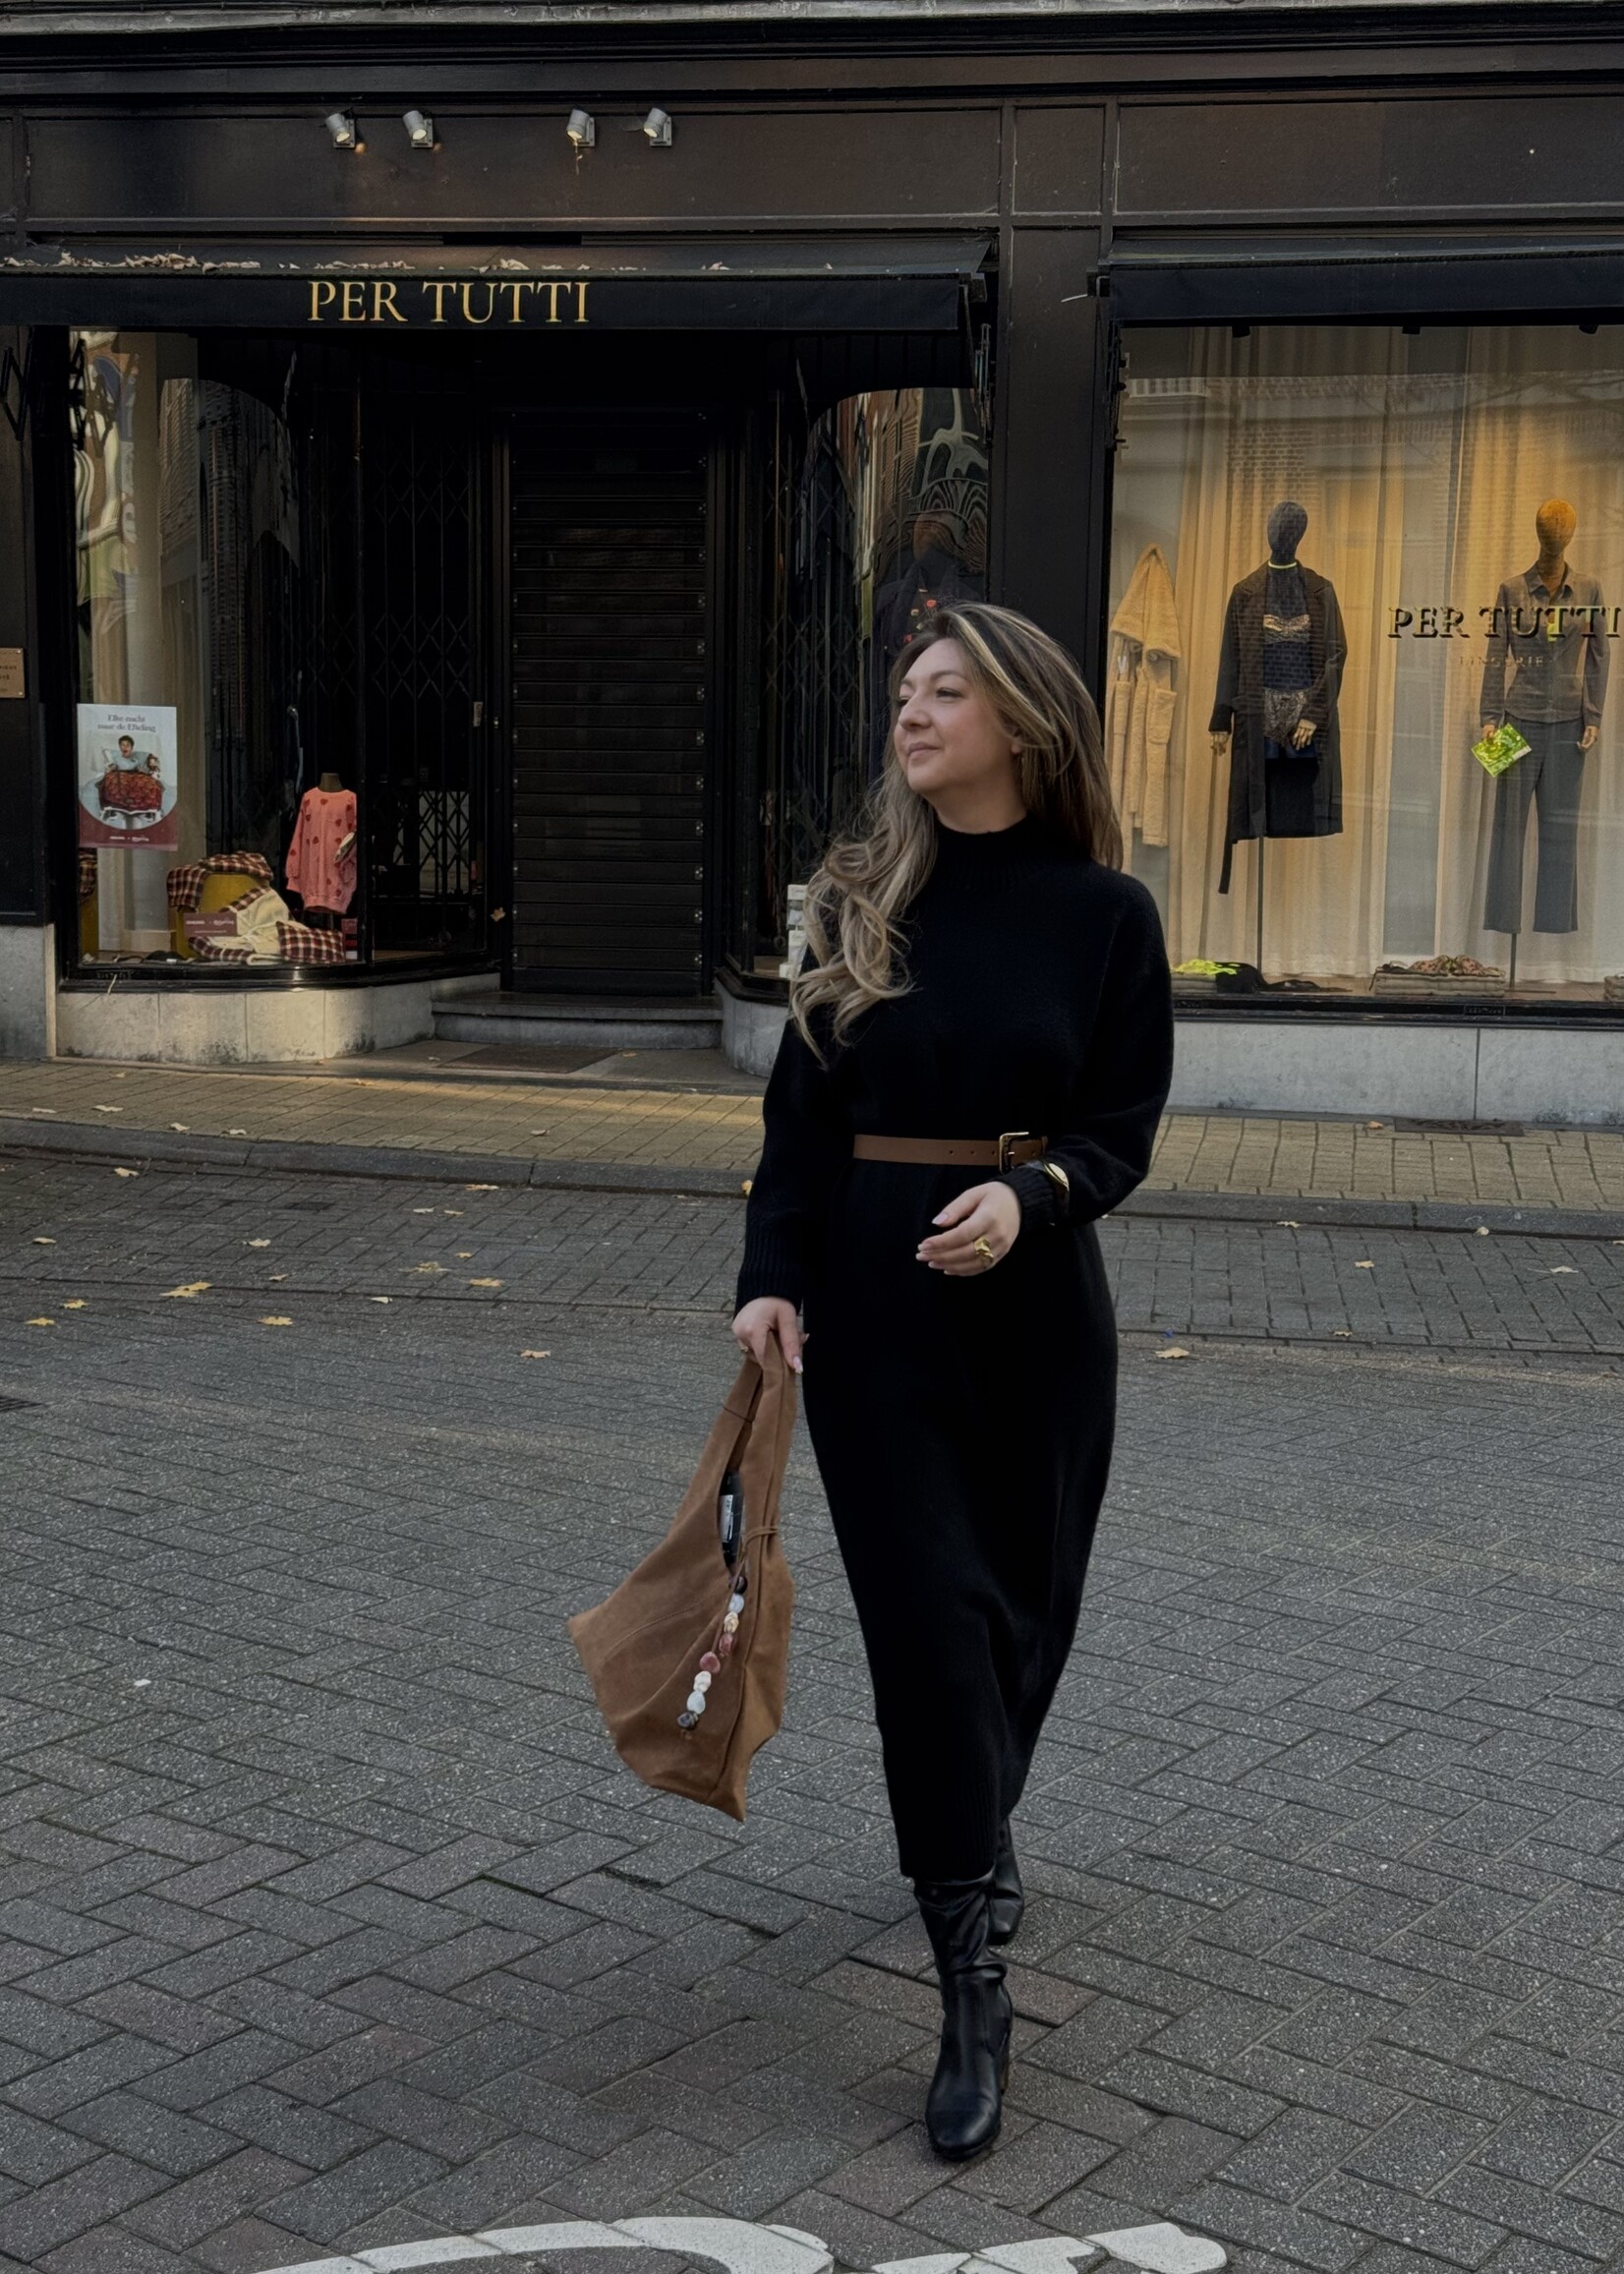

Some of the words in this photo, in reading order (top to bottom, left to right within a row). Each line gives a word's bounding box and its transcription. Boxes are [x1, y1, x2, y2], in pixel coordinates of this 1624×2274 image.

[308, 281, 409, 321] PER
[422, 281, 590, 323] TUTTI
[1387, 606, 1471, 639] PER
[1479, 606, 1622, 639] TUTTI
